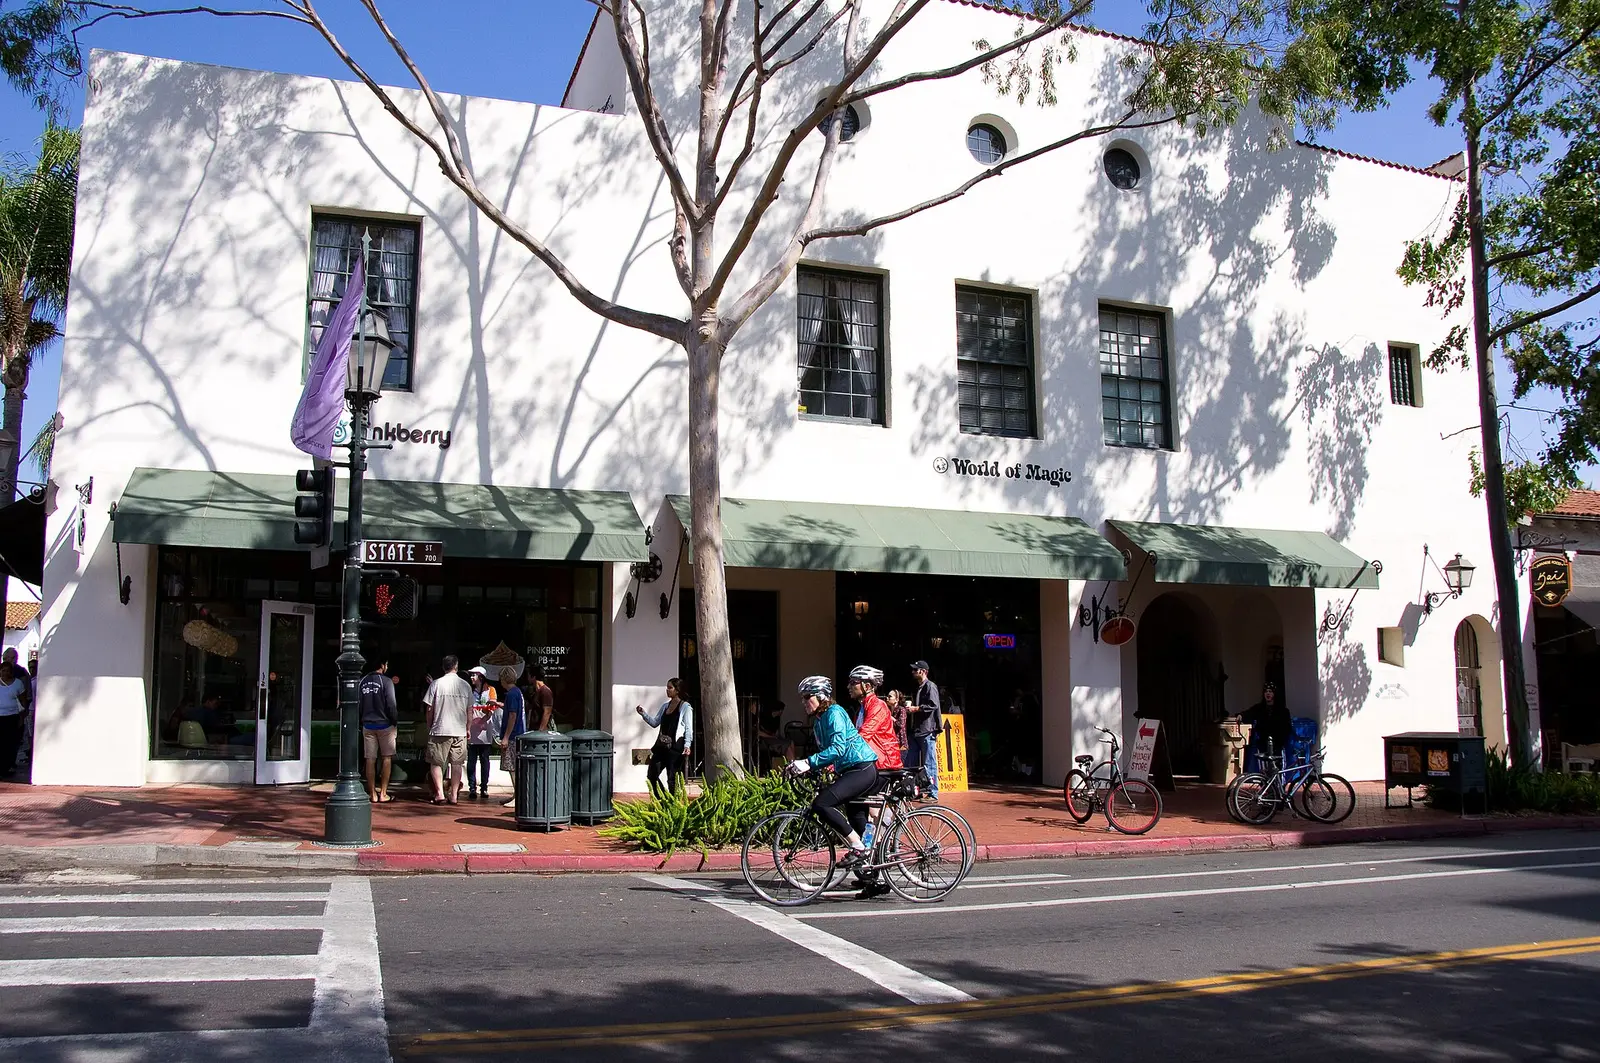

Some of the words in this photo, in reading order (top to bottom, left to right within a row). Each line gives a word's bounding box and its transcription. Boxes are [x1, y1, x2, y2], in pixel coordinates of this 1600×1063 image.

[372, 421, 451, 449] nkberry
[951, 458, 1000, 477] World
[1005, 463, 1021, 478] of
[1025, 464, 1072, 488] Magic
[368, 543, 416, 561] STATE
[425, 544, 433, 552] ST
[424, 554, 437, 562] 700
[987, 636, 1014, 647] OPEN
[527, 646, 570, 655] PINKBERRY
[538, 656, 559, 664] PB+J
[954, 722, 962, 771] COSTUMES
[1131, 762, 1148, 772] STORE
[940, 782, 957, 791] Magic
